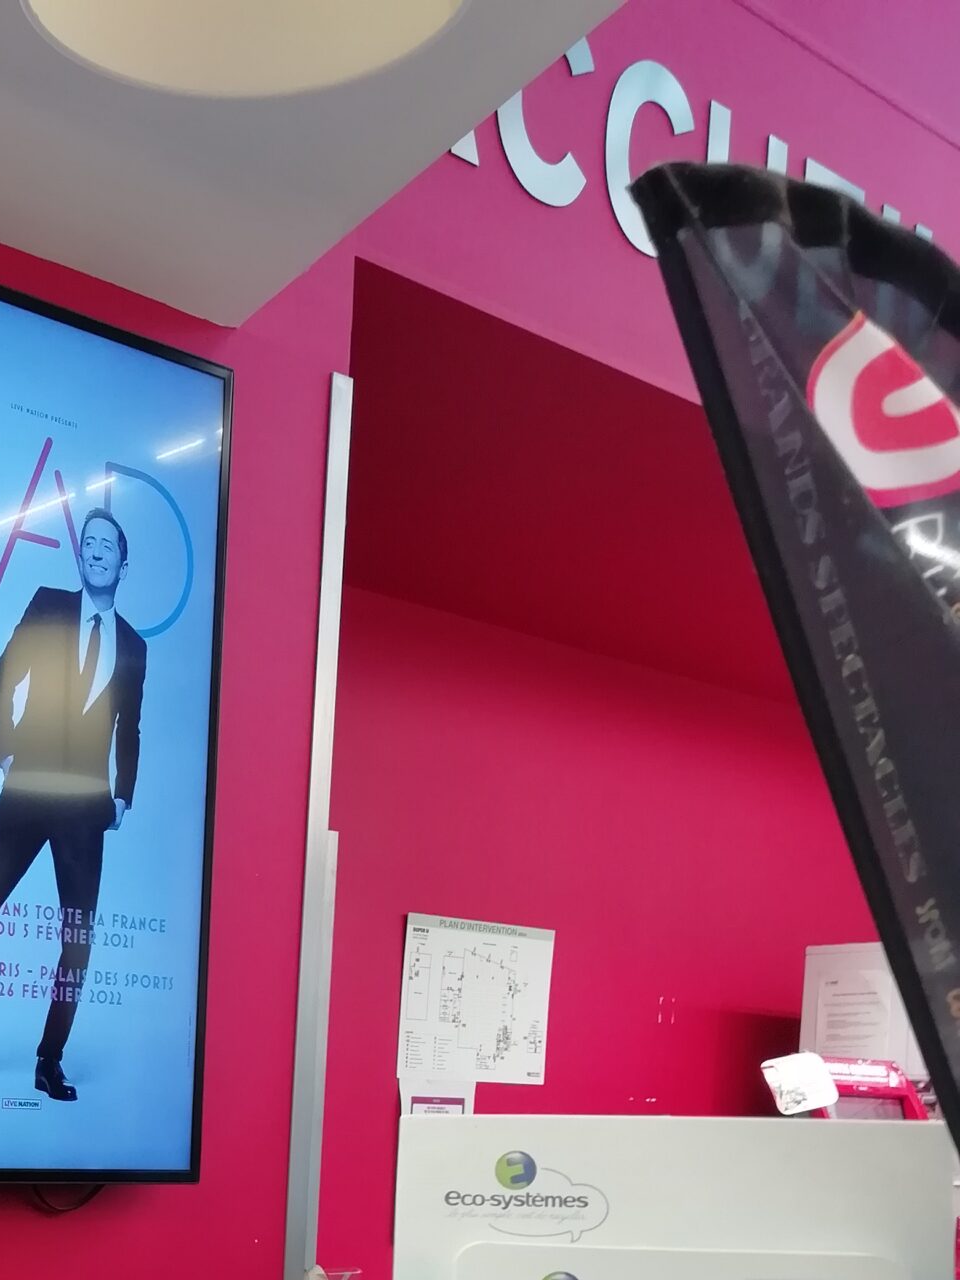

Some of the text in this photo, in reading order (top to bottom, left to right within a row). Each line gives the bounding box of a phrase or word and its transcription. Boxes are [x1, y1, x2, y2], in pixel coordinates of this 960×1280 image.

[35, 905, 82, 925] TOUTE
[89, 911, 105, 927] LA
[112, 913, 167, 933] FRANCE
[439, 919, 518, 937] PLAN D'INTERVENTION
[23, 922, 29, 938] 5
[37, 920, 97, 945] FÉVRIER
[103, 932, 134, 949] 2021
[40, 965, 88, 984] PALAIS
[94, 970, 118, 987] DES
[125, 972, 174, 991] SPORTS
[0, 980, 14, 997] 26
[22, 979, 82, 1003] FÉVRIER
[89, 989, 123, 1006] 2022
[444, 1188, 589, 1211] eco-systèmes
